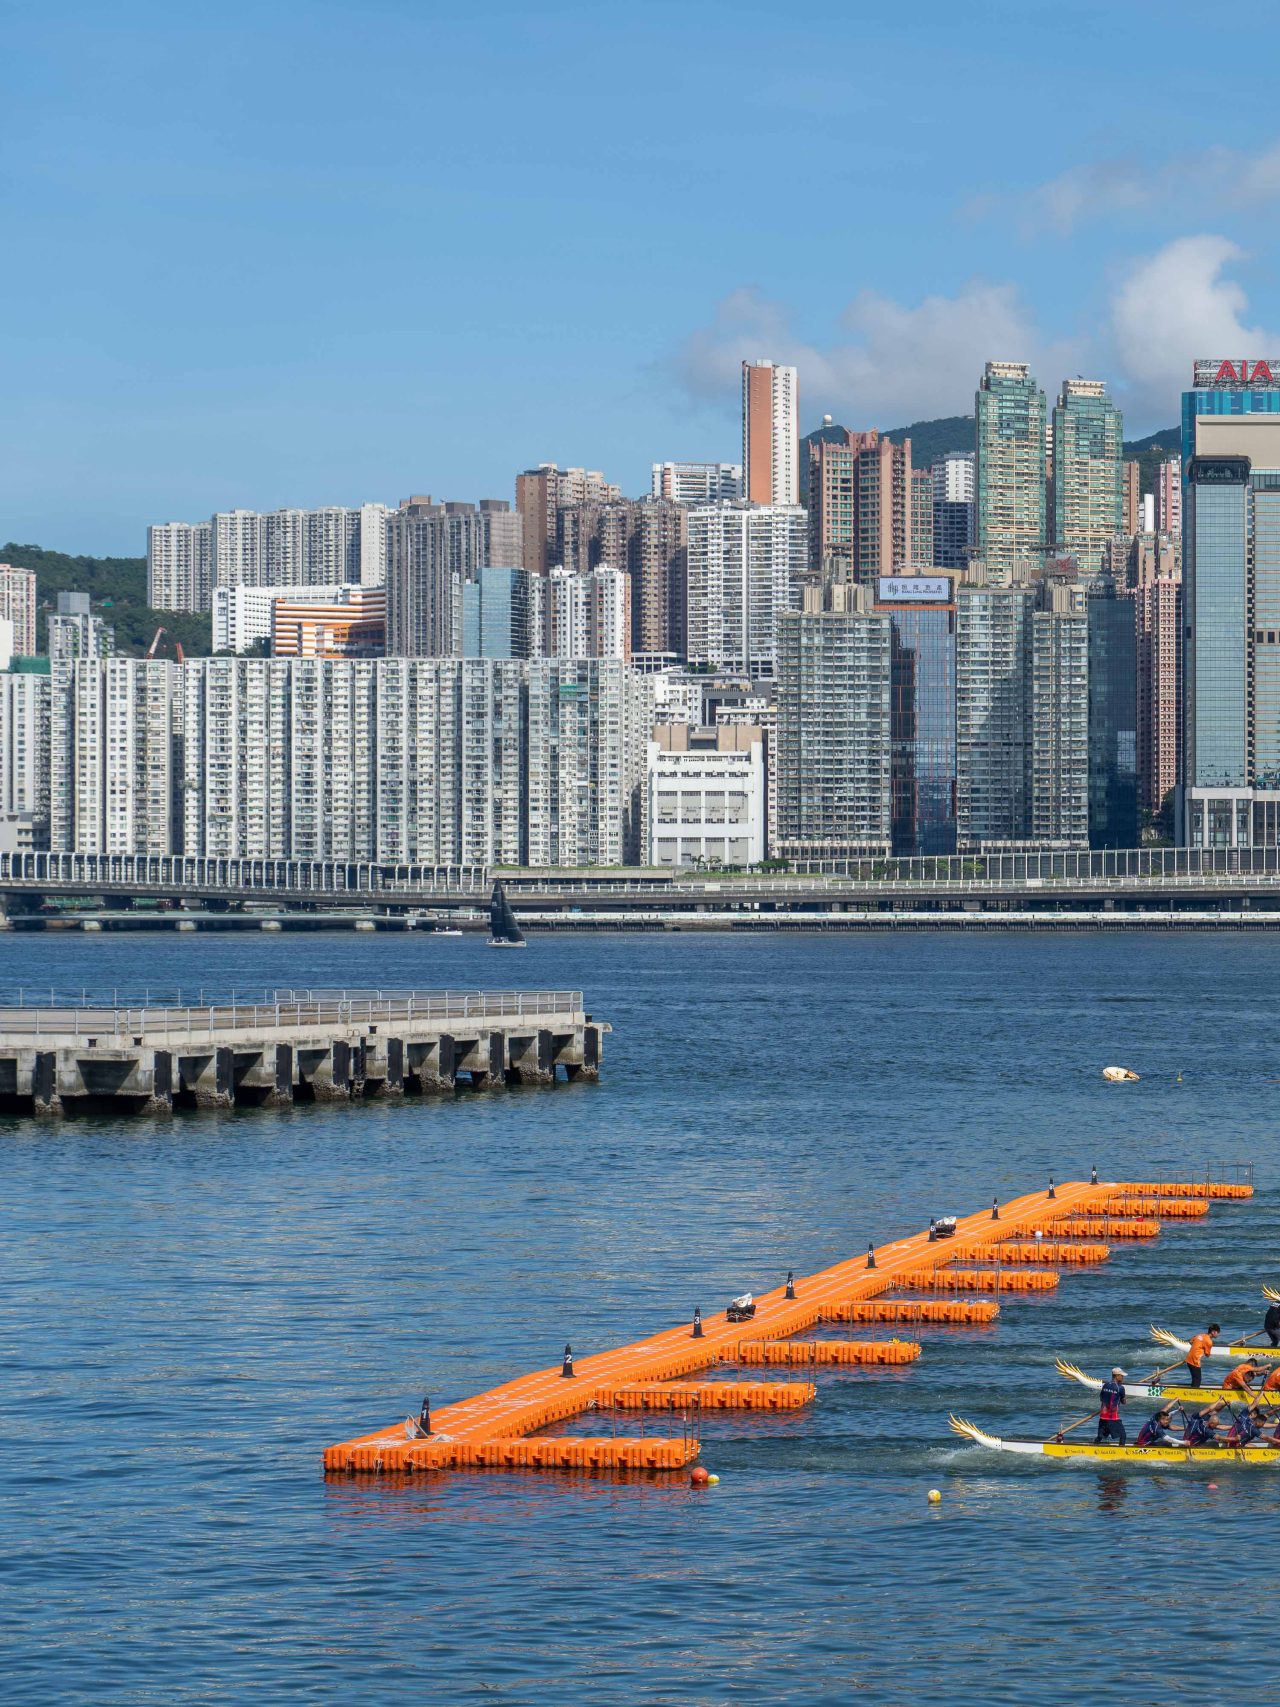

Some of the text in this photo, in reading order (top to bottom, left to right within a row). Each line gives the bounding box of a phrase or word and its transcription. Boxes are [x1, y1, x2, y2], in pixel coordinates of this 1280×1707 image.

[1215, 360, 1273, 381] AIA
[787, 1280, 793, 1288] 4
[695, 1316, 700, 1324] 3
[566, 1354, 572, 1363] 2
[422, 1410, 427, 1419] 1
